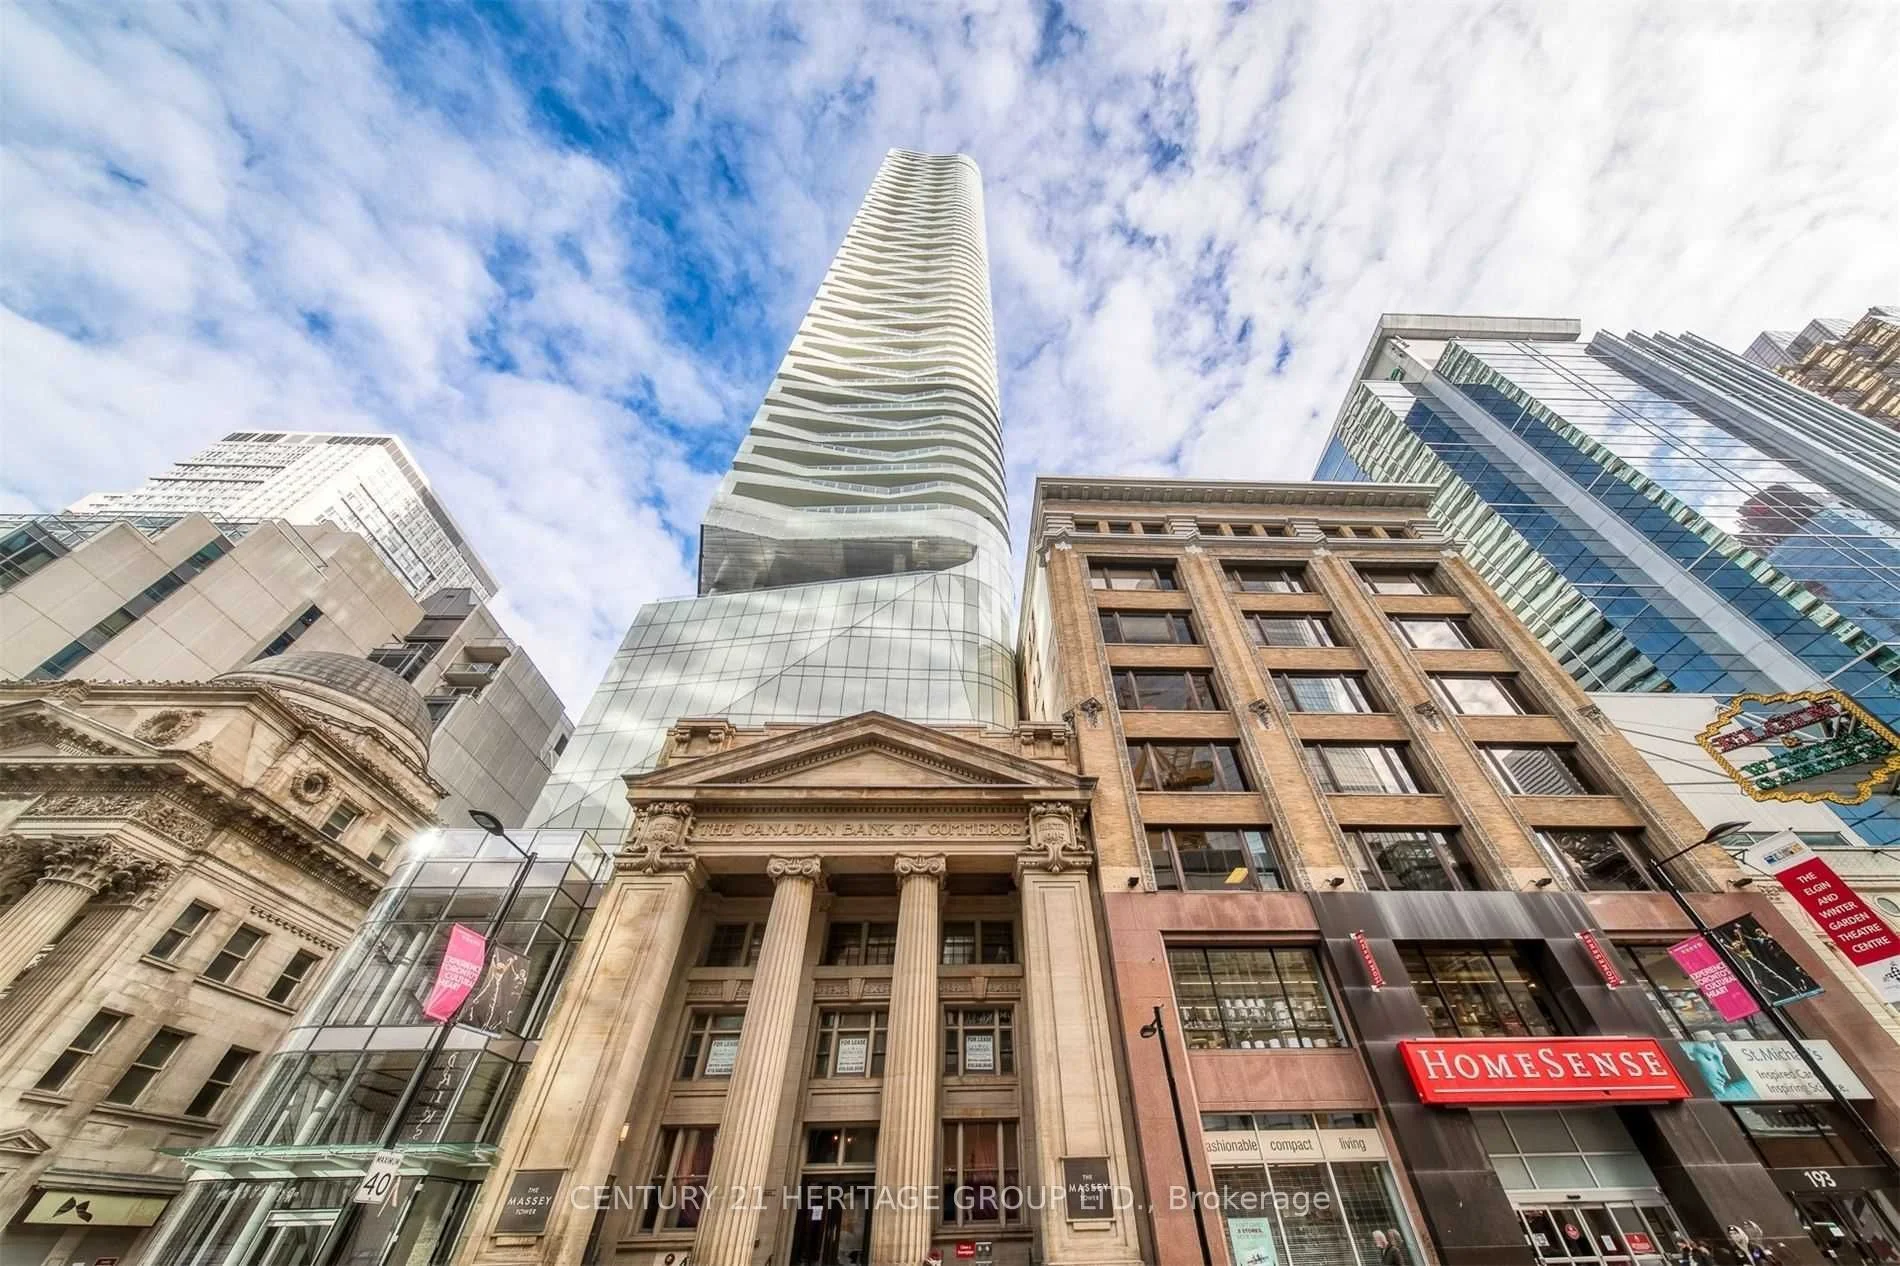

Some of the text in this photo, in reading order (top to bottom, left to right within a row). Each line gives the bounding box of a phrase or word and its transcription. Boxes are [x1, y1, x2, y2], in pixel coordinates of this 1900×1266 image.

[700, 823, 1021, 837] THE CANADIAN BANK OF COMMERCE
[1796, 871, 1818, 884] THE
[1803, 881, 1832, 896] ELGIN
[1817, 893, 1839, 906] AND
[1819, 901, 1858, 919] WINTER
[1828, 912, 1870, 931] GARDEN
[1837, 922, 1883, 943] THEATRE
[1851, 936, 1892, 953] CENTRE
[1270, 1138, 1313, 1153] compact
[1338, 1137, 1367, 1153] living
[363, 1172, 392, 1196] 40
[1804, 1170, 1837, 1188] 193
[1068, 1183, 1109, 1193] MASSEY
[507, 1196, 552, 1206] MASSEY
[515, 1208, 537, 1216] TOWER
